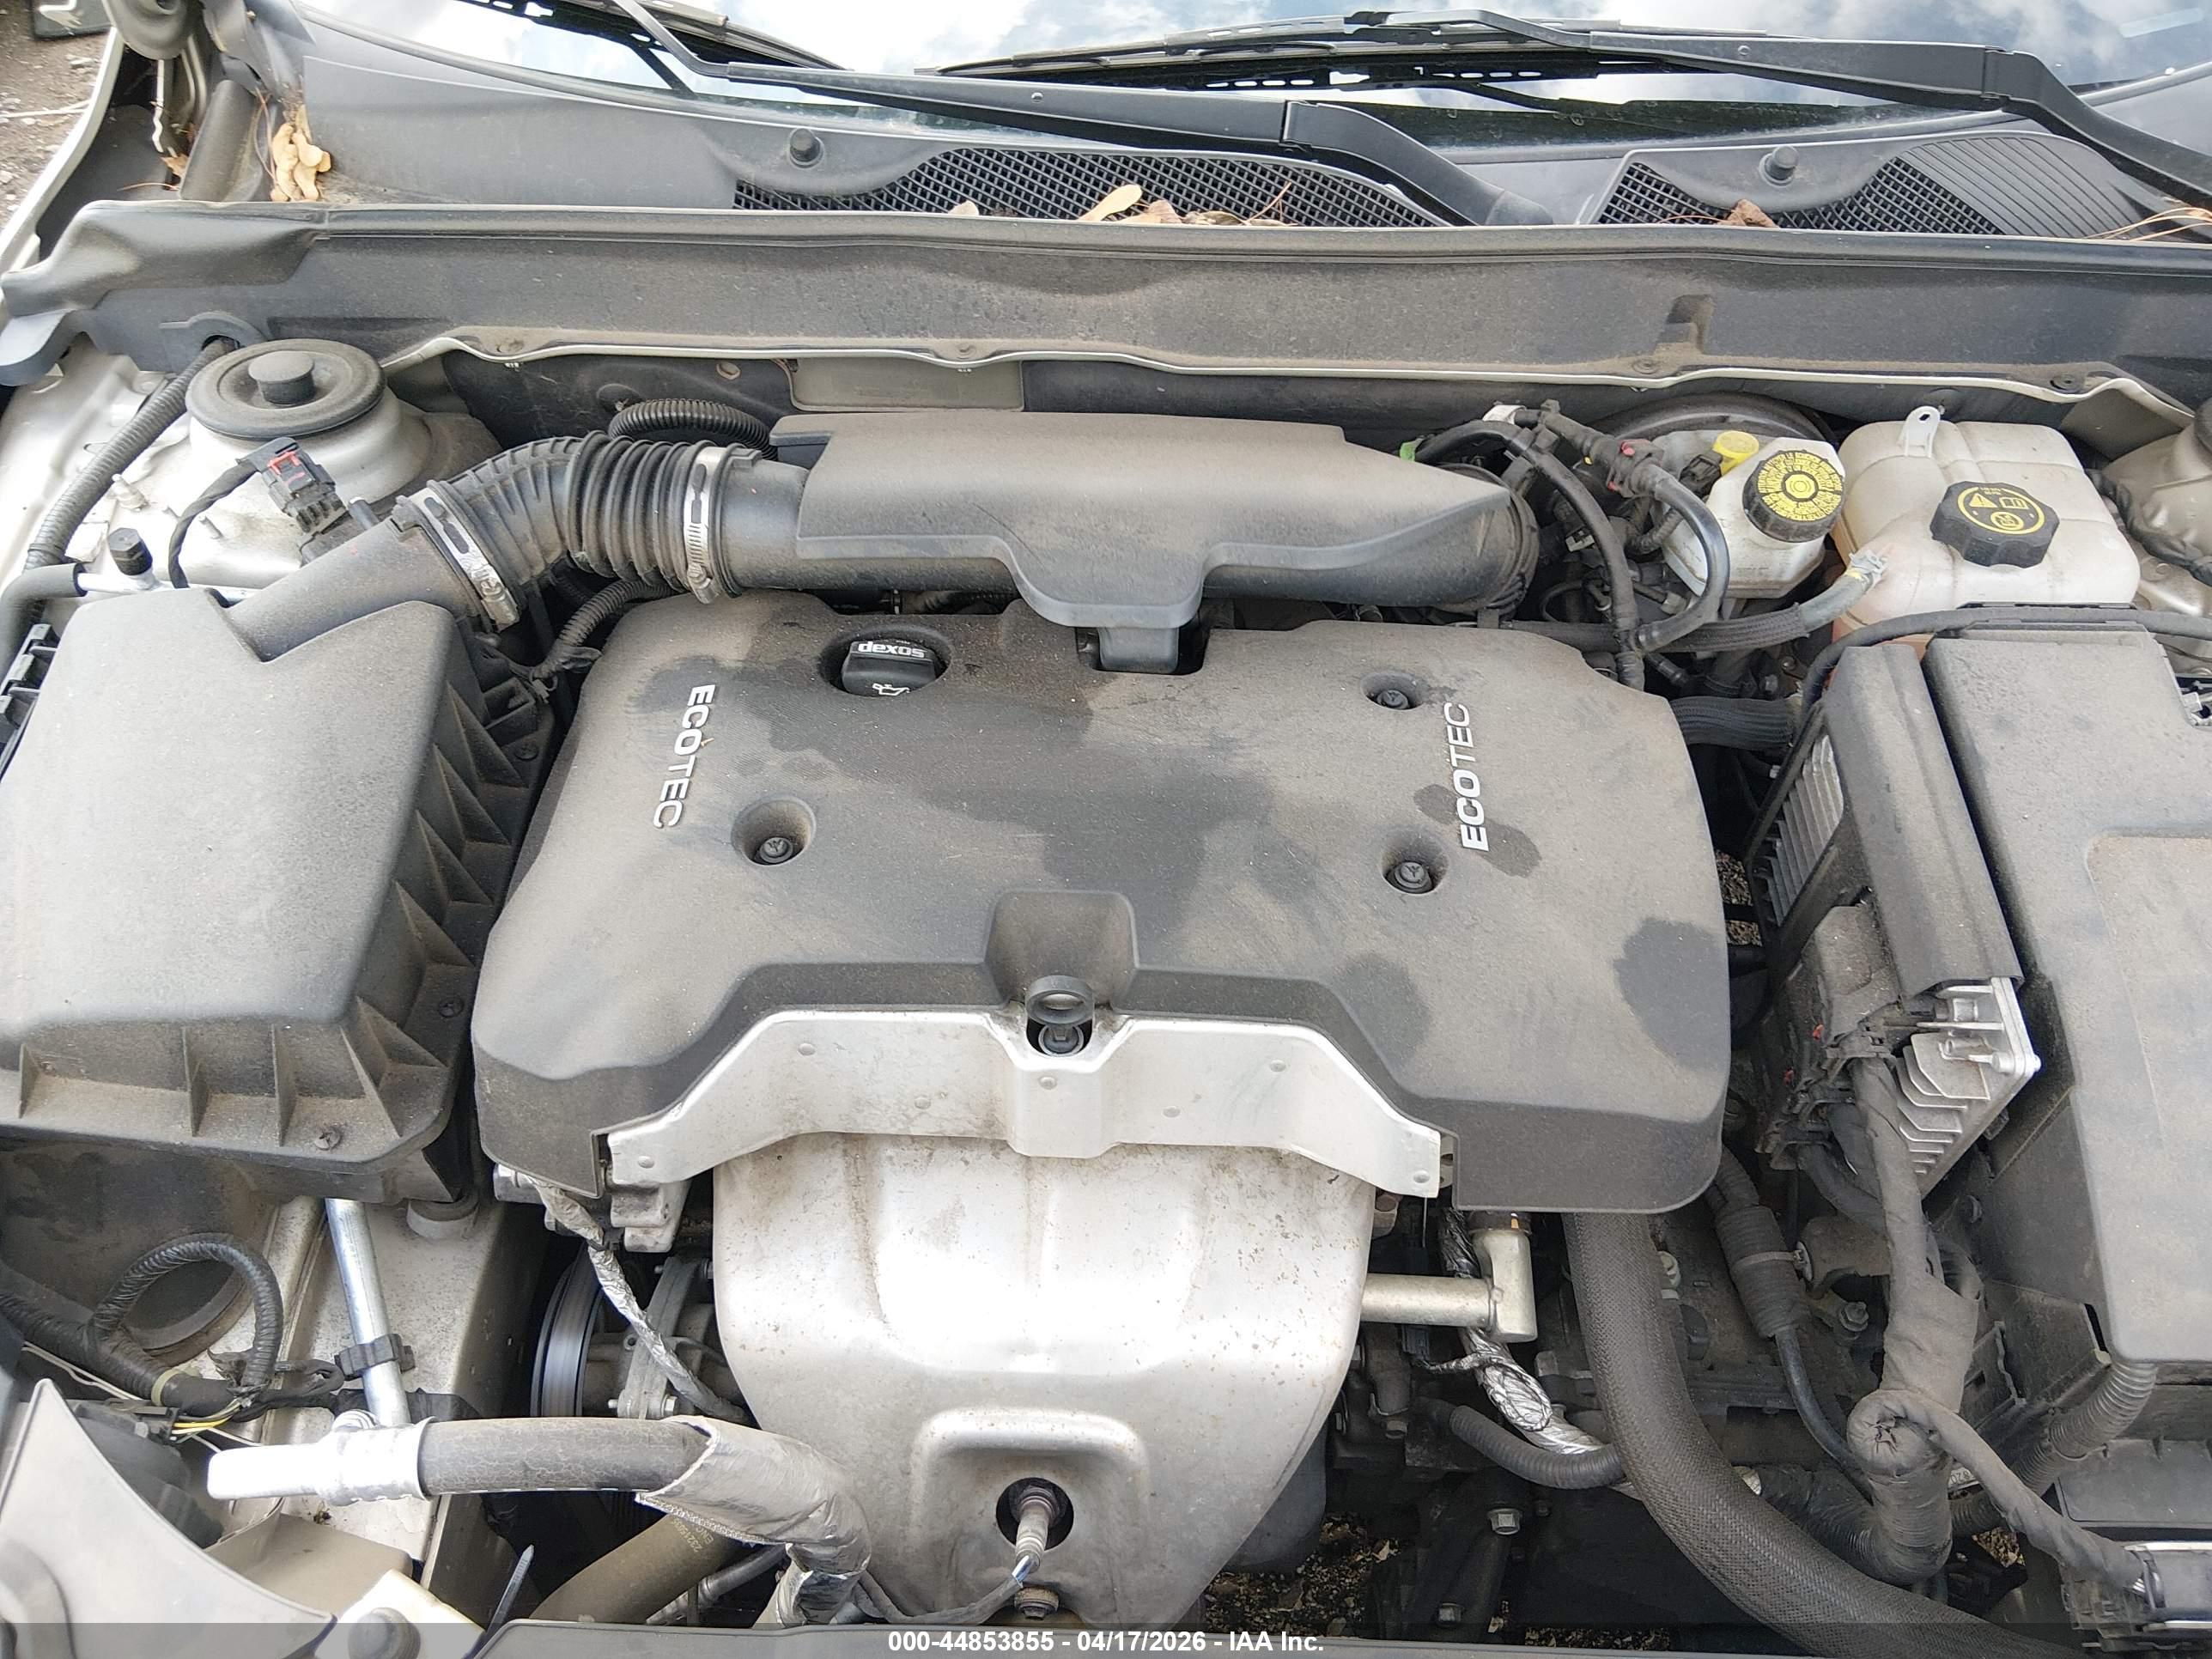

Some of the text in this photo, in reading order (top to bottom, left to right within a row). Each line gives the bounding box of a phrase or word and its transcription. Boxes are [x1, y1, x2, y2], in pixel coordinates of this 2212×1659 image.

[858, 641, 925, 659] dexos
[653, 684, 715, 829] ECOTEC
[1444, 702, 1489, 851] ECOTEC
